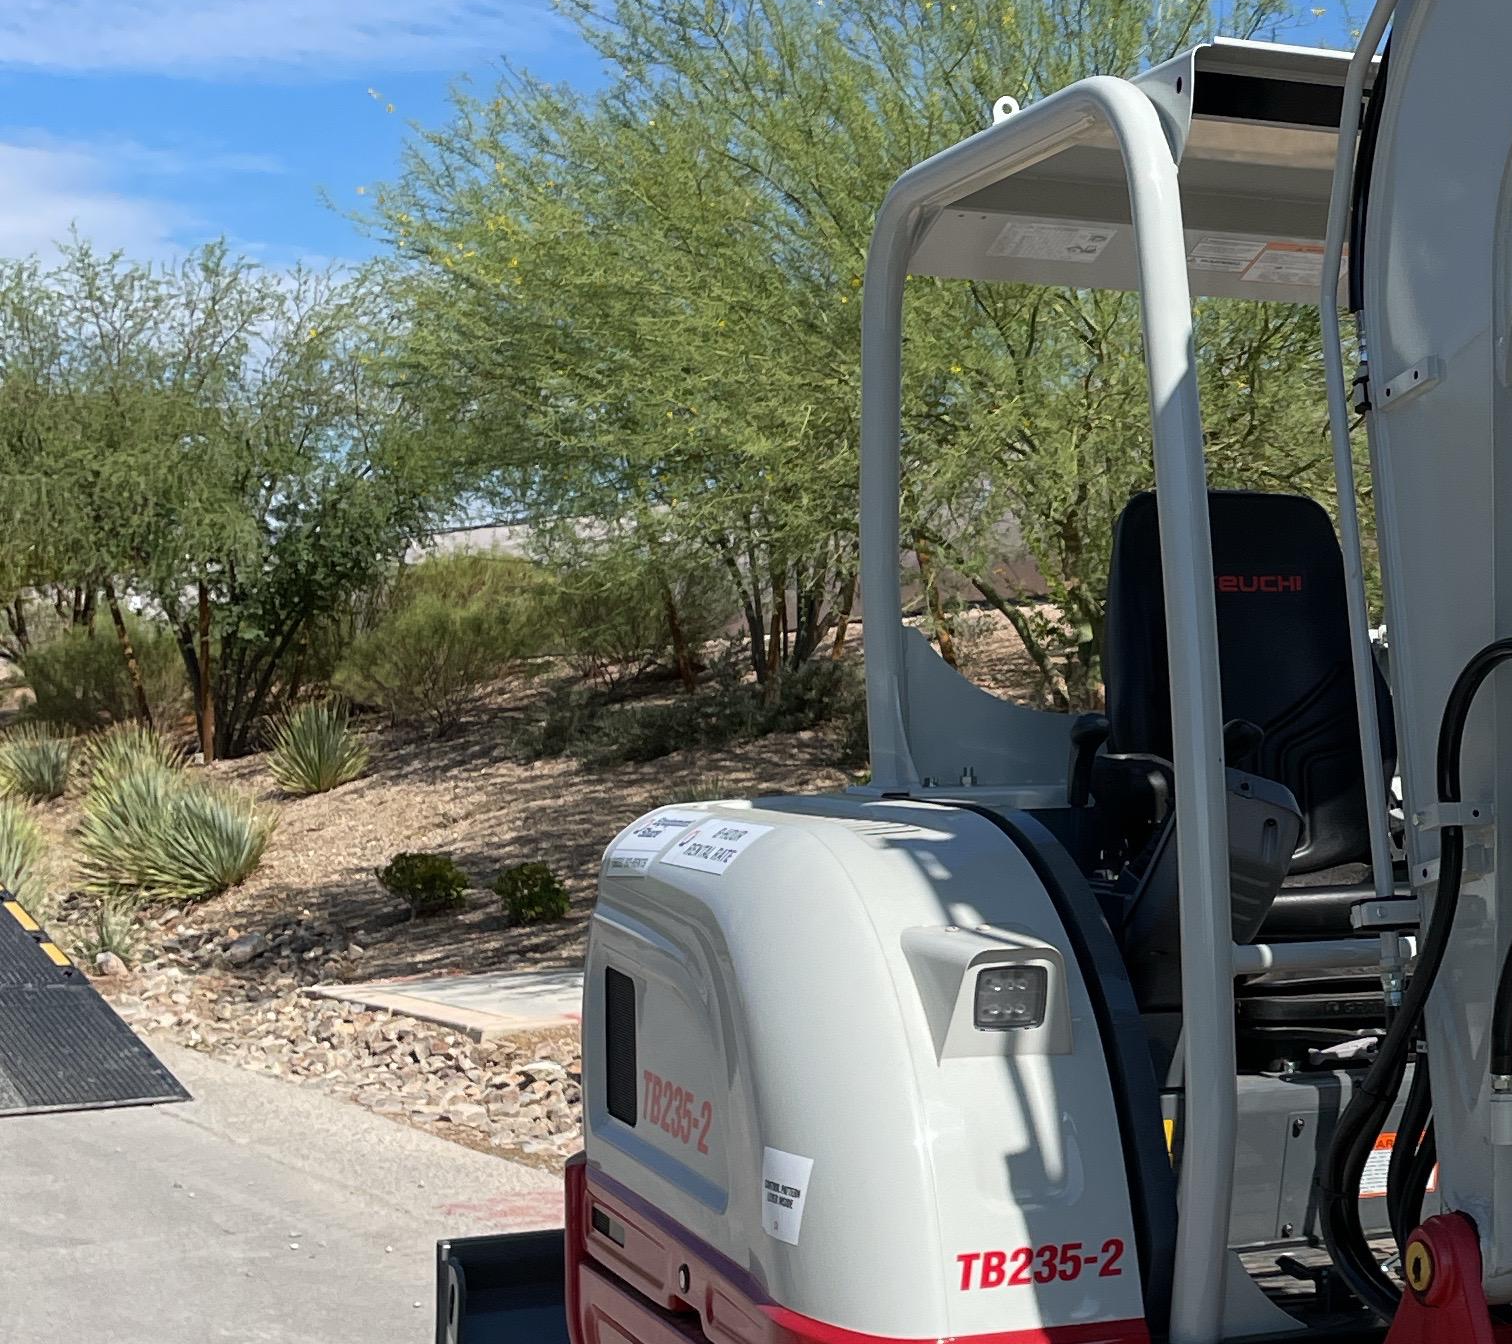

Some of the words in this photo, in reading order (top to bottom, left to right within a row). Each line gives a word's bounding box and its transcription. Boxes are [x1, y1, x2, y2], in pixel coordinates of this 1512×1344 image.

[1216, 575, 1302, 592] EUCHI
[643, 1069, 714, 1155] TB235-2
[956, 1238, 1124, 1291] TB235-2
